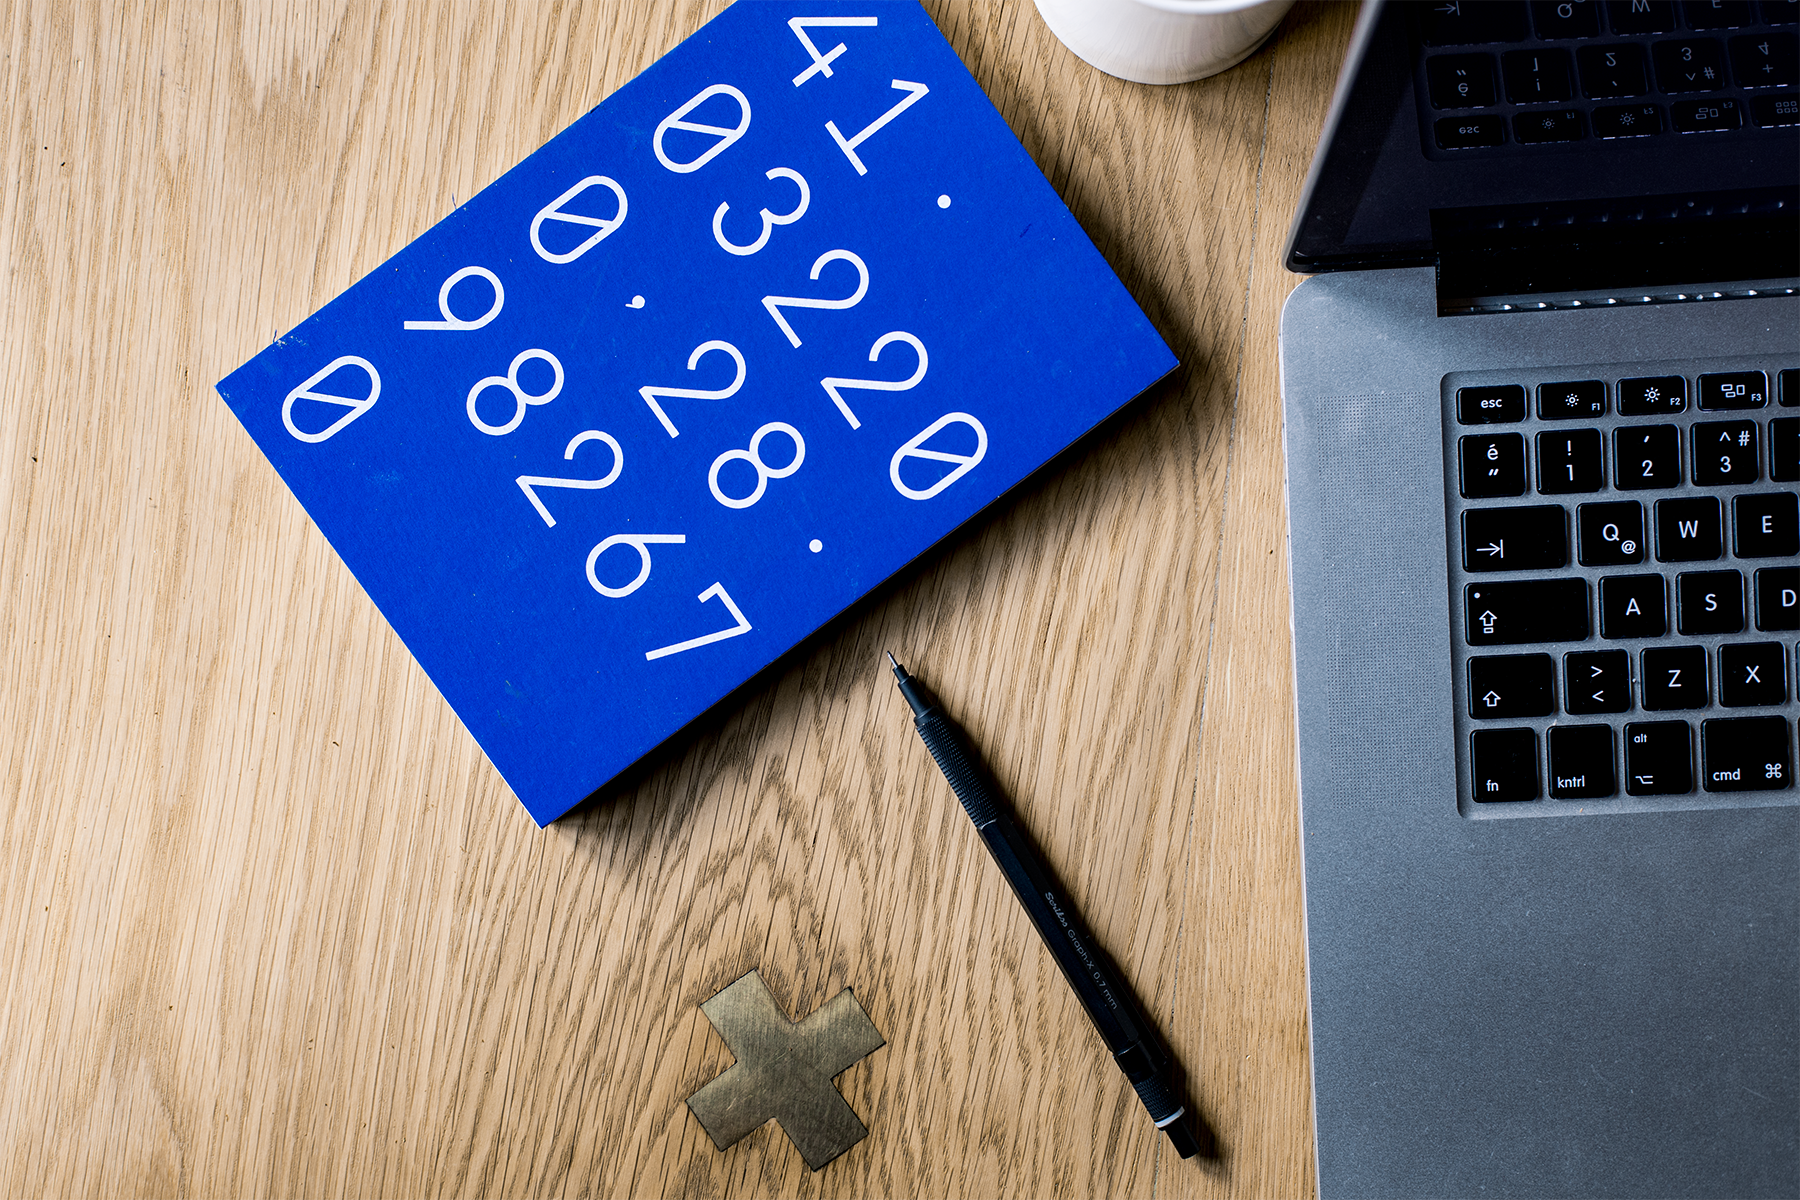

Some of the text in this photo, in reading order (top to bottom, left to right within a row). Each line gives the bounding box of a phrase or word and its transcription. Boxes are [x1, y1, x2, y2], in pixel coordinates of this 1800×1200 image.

[1480, 398, 1503, 409] esc
[1591, 402, 1601, 411] F1
[1669, 397, 1681, 406] F2
[1750, 393, 1762, 402] F3
[1737, 430, 1751, 447] #
[1486, 443, 1499, 461] é
[1566, 440, 1572, 457] !
[1565, 464, 1574, 482] 1
[1641, 459, 1654, 477] 2
[1719, 455, 1732, 473] 3
[1602, 523, 1620, 541] Q
[1678, 519, 1699, 539] W
[1761, 515, 1773, 534] E
[1620, 539, 1637, 555] @
[1625, 597, 1642, 616] A
[1704, 593, 1718, 612] S
[1781, 588, 1797, 608] D
[1667, 669, 1682, 688] Z
[1745, 665, 1761, 684] X
[1633, 733, 1648, 744] alt
[1556, 774, 1586, 789] kntrl
[1712, 767, 1741, 782] cmd
[1485, 779, 1499, 792] fn
[1103, 988, 1118, 1010] mm
